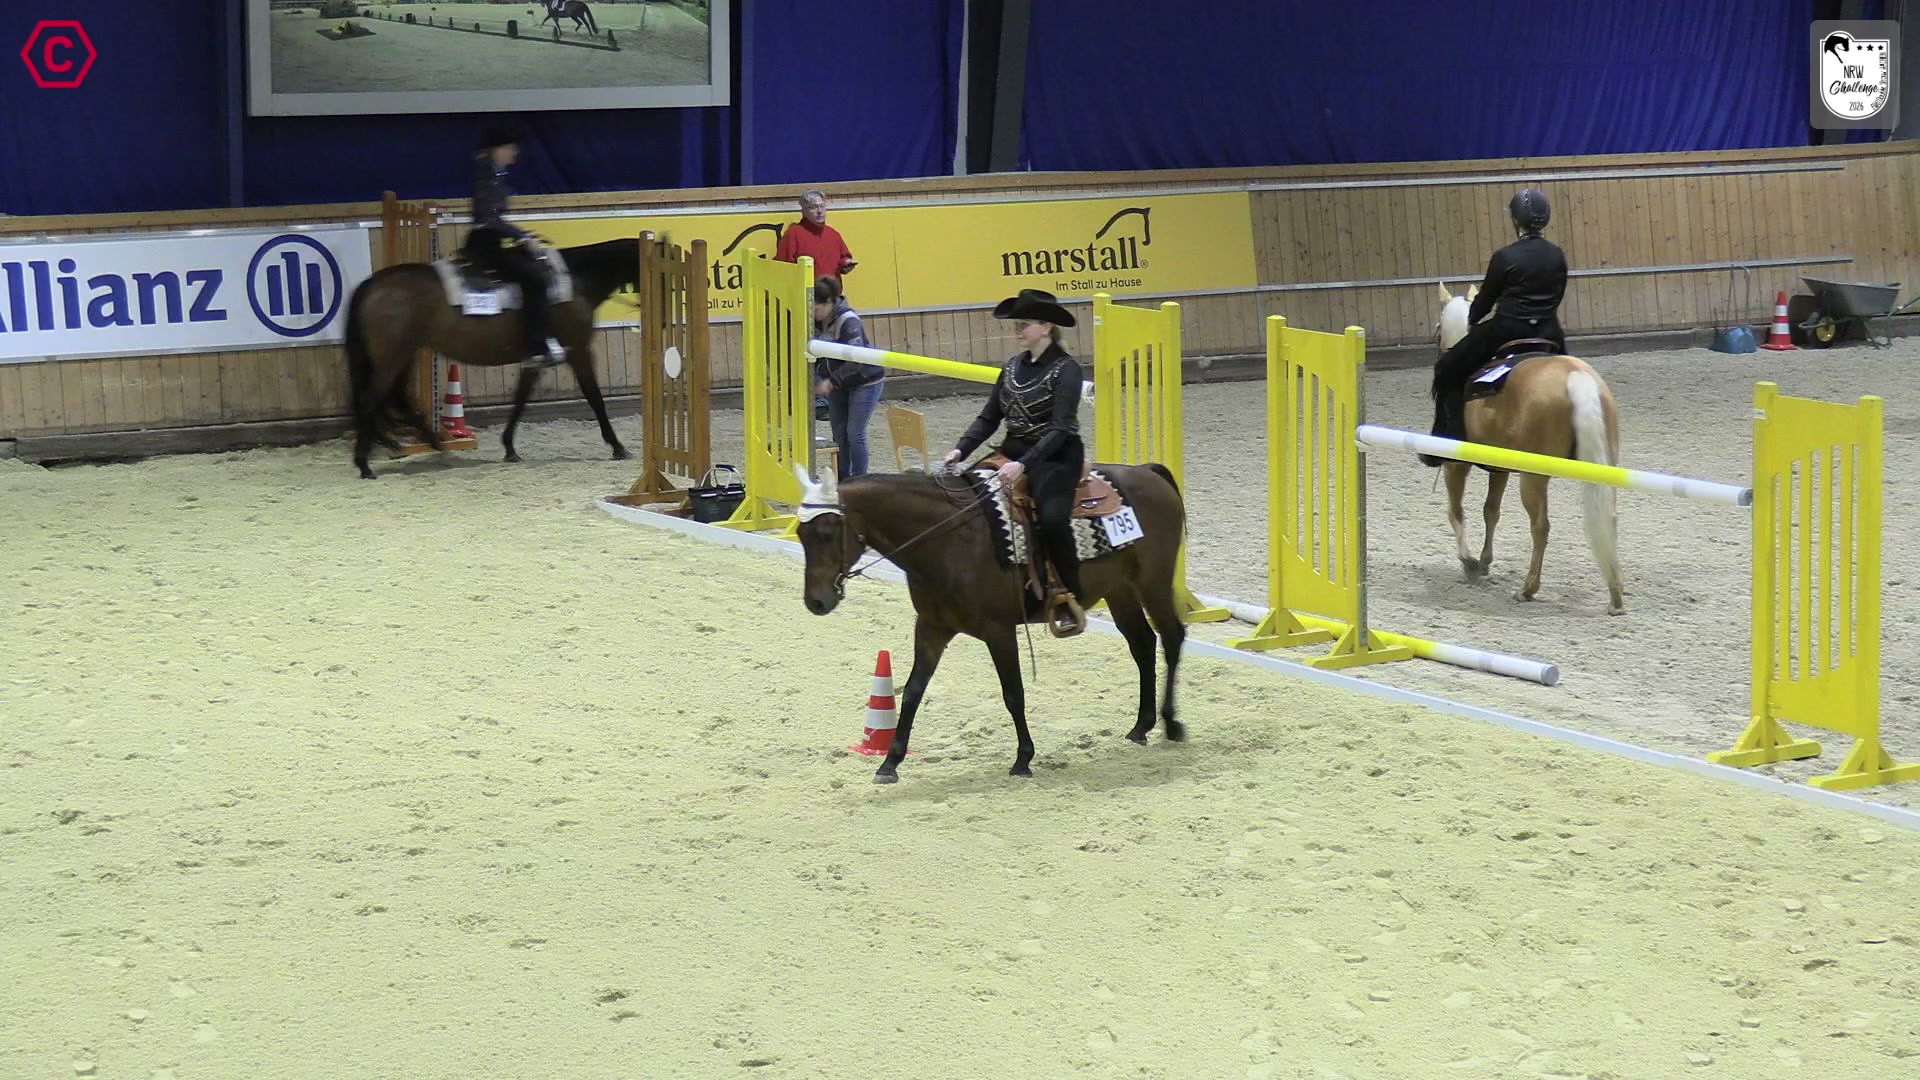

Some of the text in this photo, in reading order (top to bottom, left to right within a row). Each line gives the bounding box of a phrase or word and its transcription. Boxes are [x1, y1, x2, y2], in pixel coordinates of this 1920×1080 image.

[1001, 236, 1141, 277] marstall
[0, 258, 228, 333] llianz
[1056, 277, 1142, 291] Im Stall zu Hause
[708, 298, 719, 309] all
[721, 300, 734, 309] zu
[1108, 512, 1134, 537] 795
